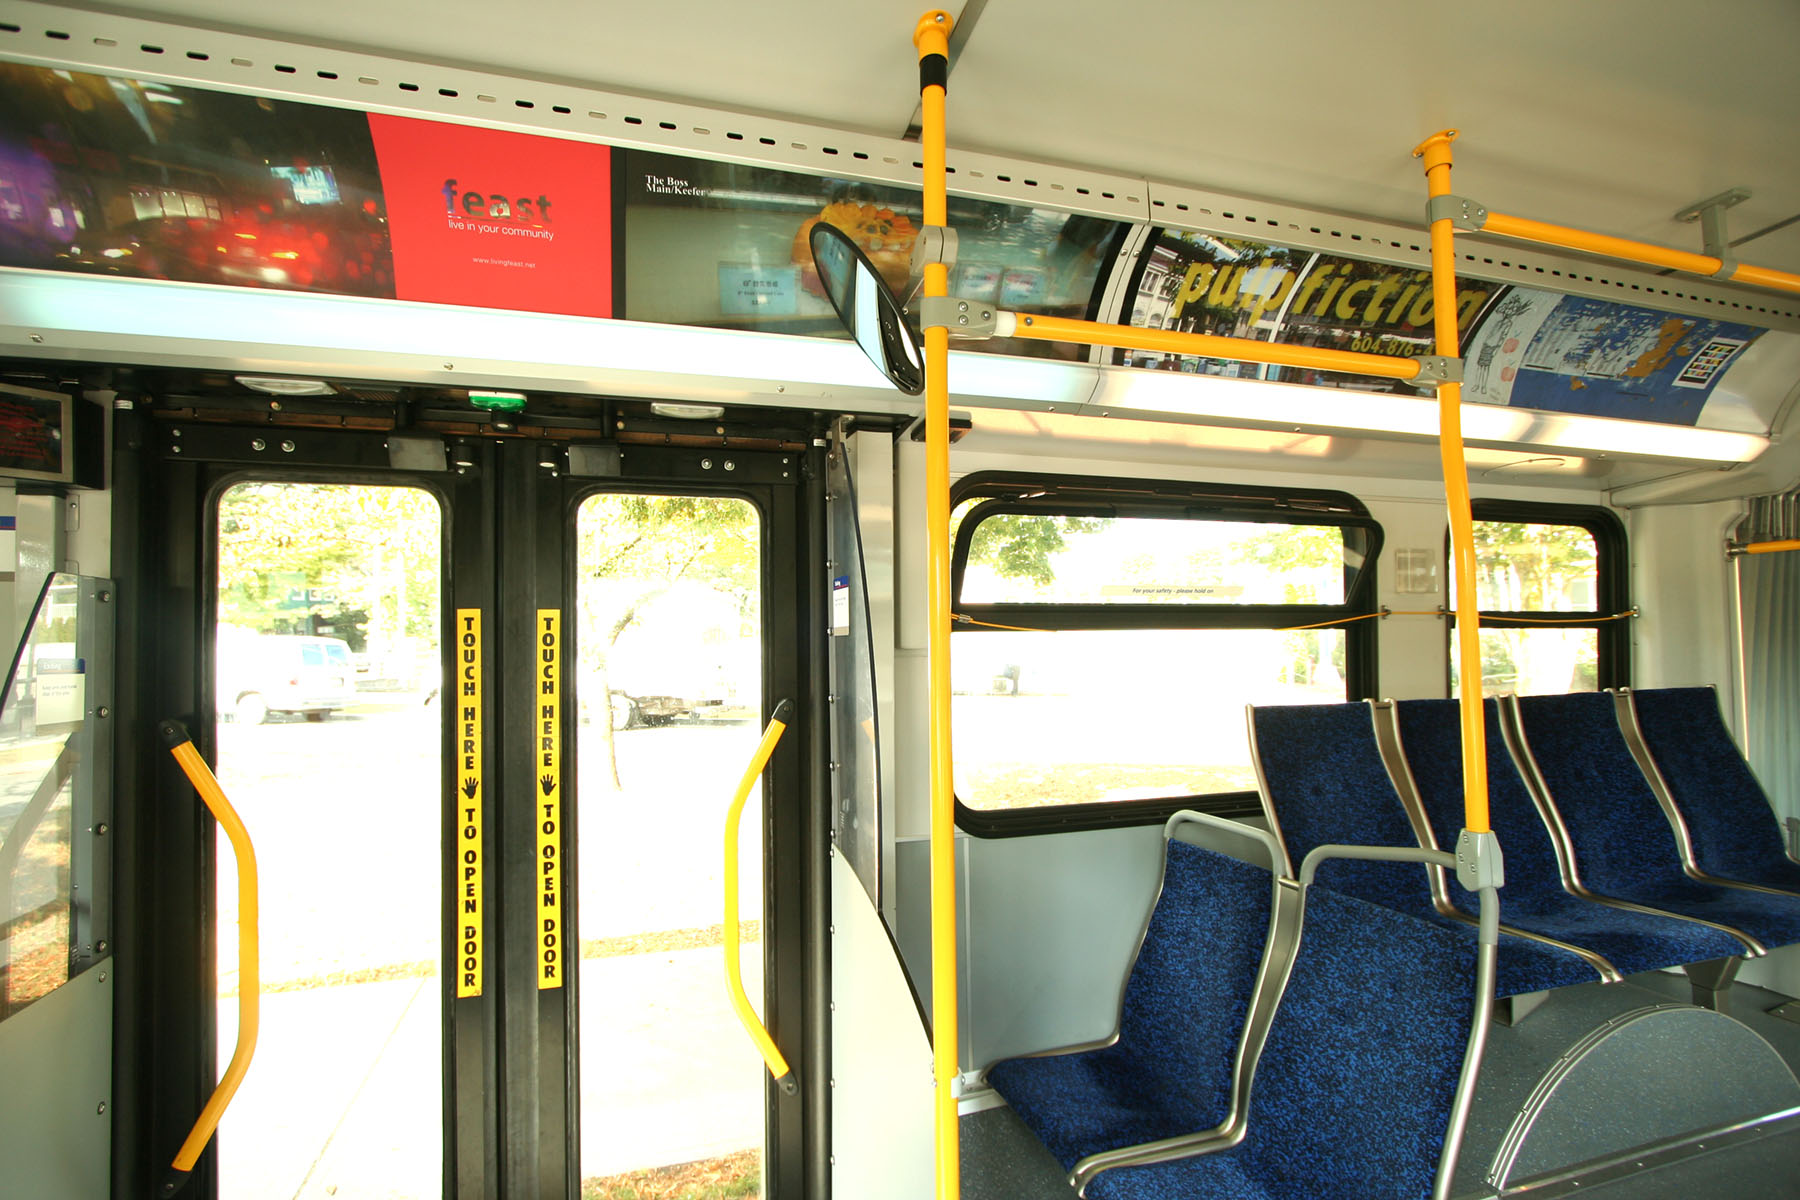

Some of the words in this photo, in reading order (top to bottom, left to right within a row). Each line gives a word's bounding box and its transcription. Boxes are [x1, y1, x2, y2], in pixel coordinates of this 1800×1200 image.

[442, 179, 553, 223] feast
[645, 174, 665, 186] The
[667, 177, 689, 187] Boss
[646, 183, 706, 197] Main/Keefer
[448, 219, 465, 231] live
[466, 220, 476, 232] in
[478, 223, 500, 235] your
[501, 226, 554, 242] community
[1169, 257, 1298, 327] pulp
[1156, 587, 1172, 595] safety
[1175, 587, 1193, 595] please
[463, 617, 476, 697] TOUCH
[542, 617, 555, 695] TOUCH
[463, 706, 476, 770] HERE
[541, 704, 554, 768] HERE
[464, 807, 477, 841] TO
[542, 803, 555, 836] TO
[464, 849, 477, 914] OPEN
[542, 844, 555, 908] OPEN
[464, 925, 478, 988] DOOR
[543, 918, 556, 980] DOOR
